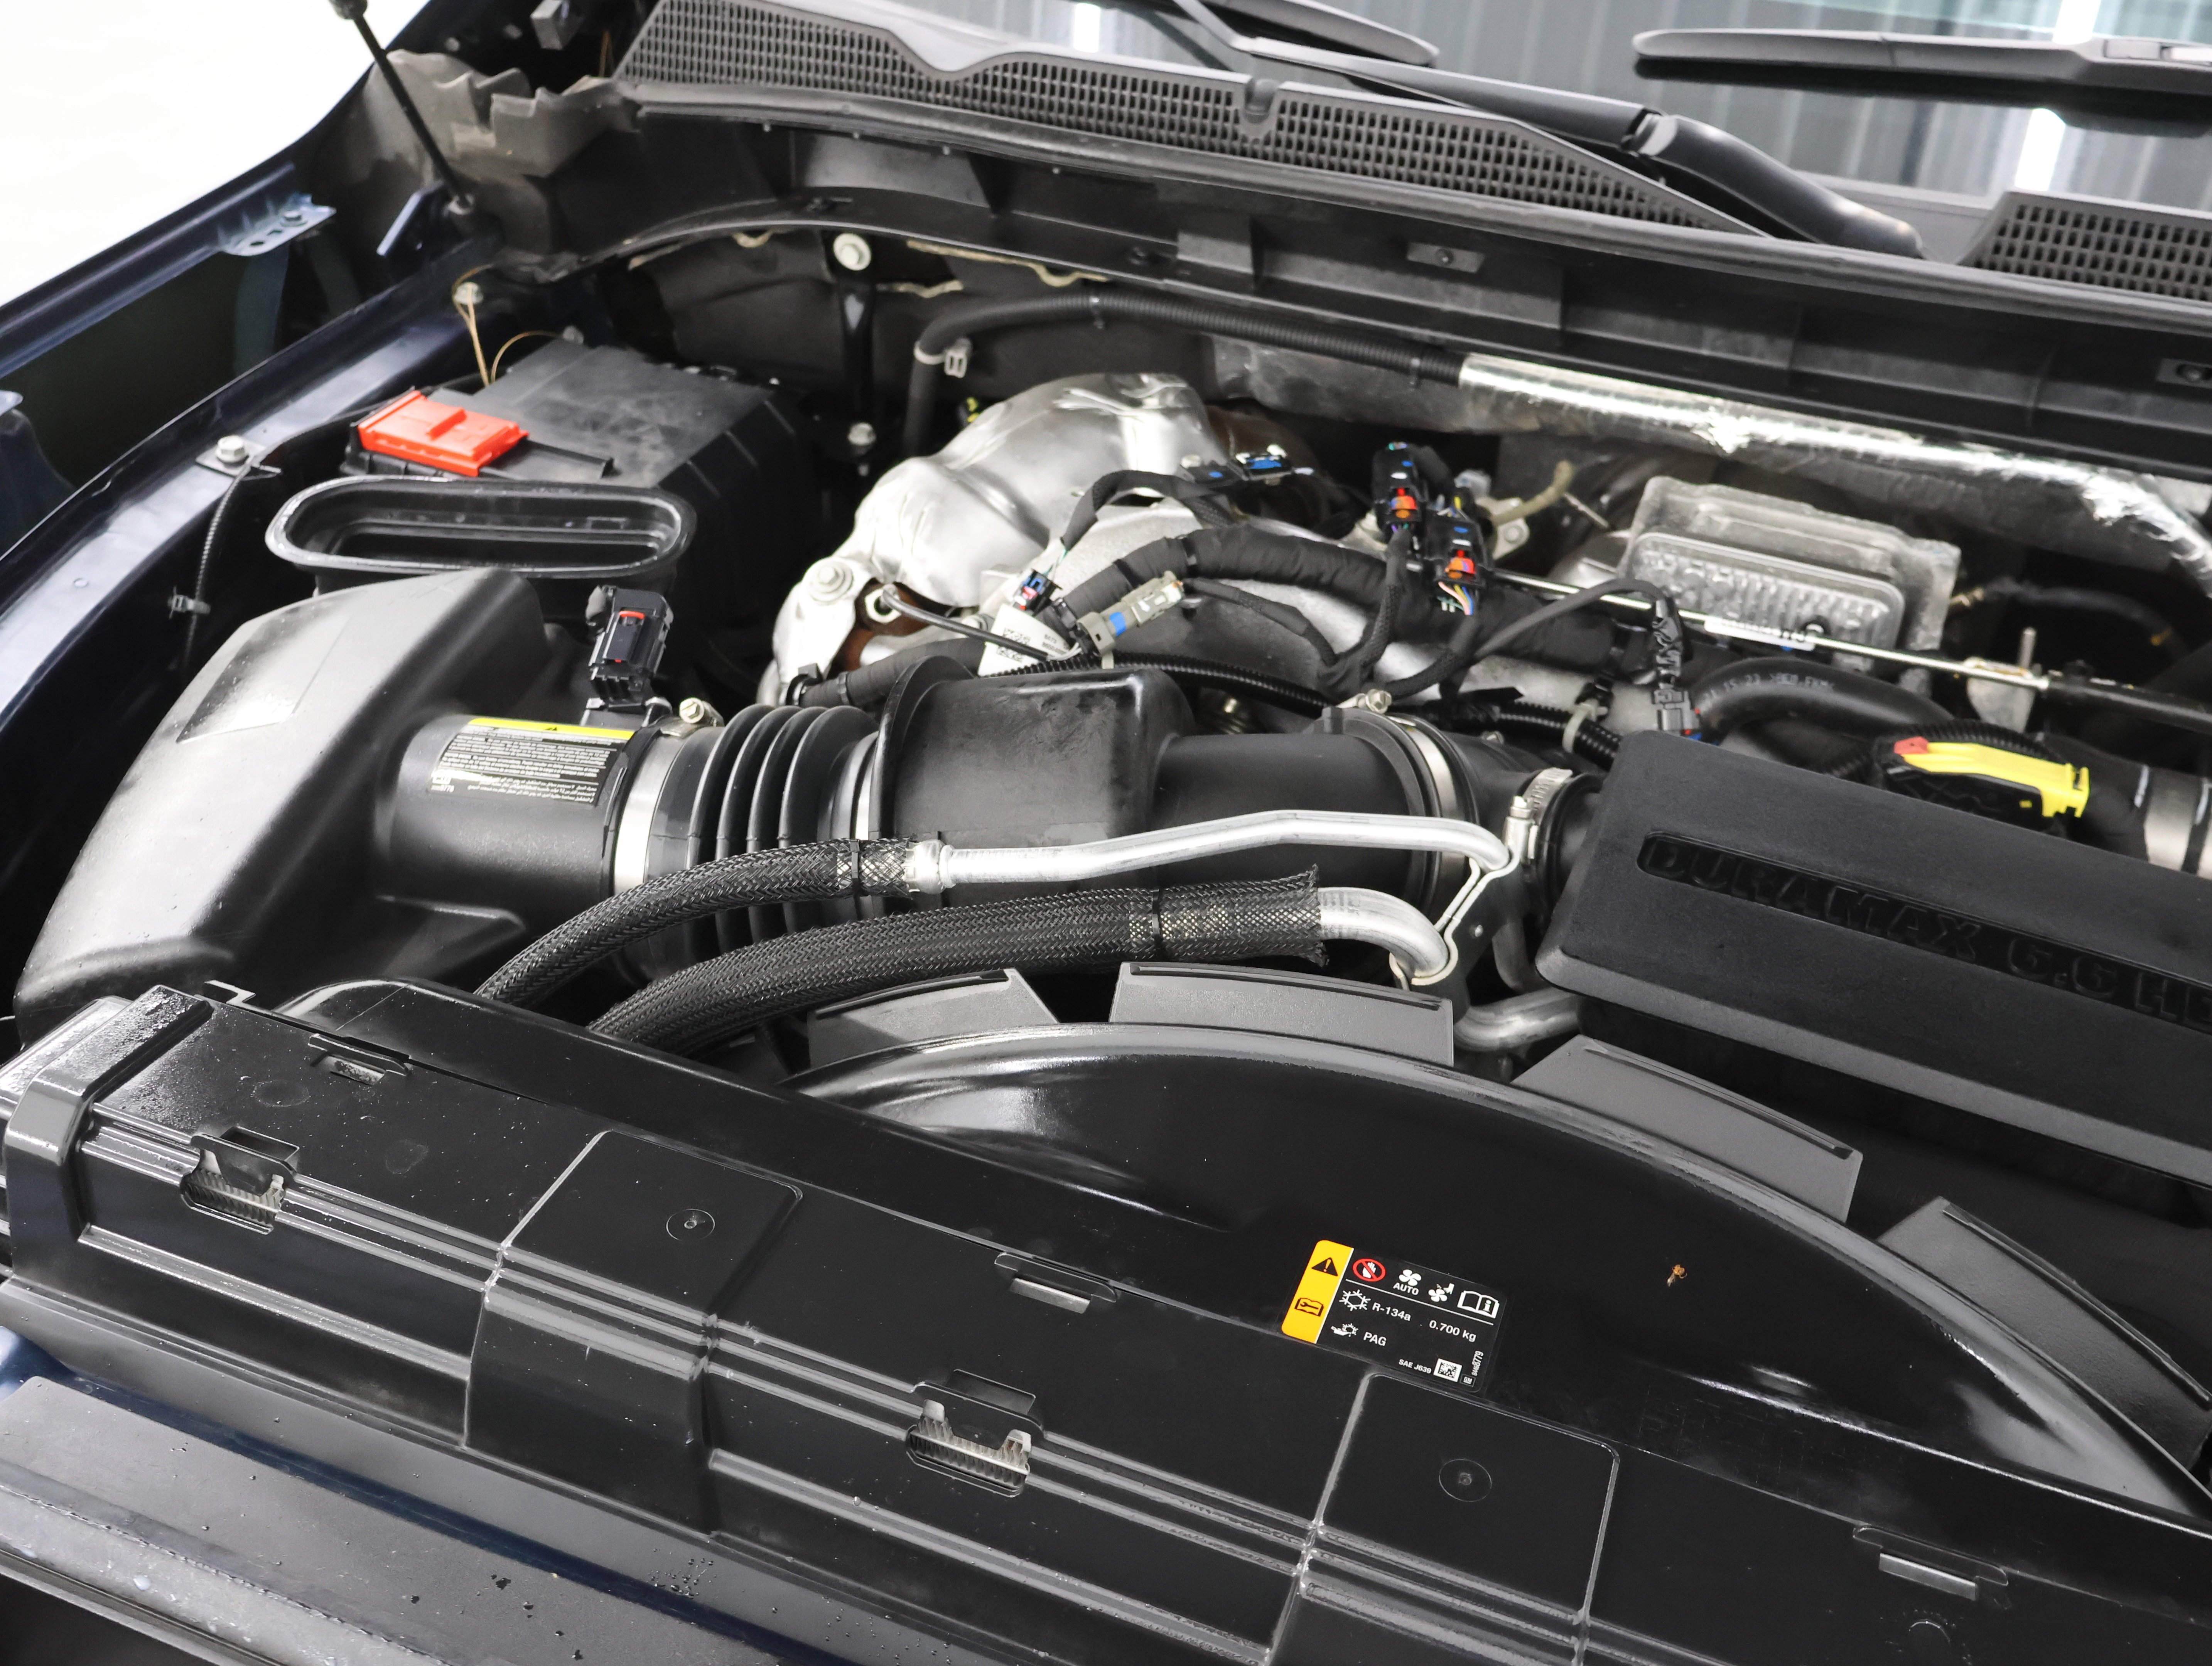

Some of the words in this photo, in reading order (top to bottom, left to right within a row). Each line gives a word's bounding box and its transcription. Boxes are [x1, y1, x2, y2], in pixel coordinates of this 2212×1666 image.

[1647, 839, 1981, 962] DURAMAX
[2008, 936, 2118, 999] 6.6
[1393, 1282, 1419, 1295] AUTO
[1372, 1302, 1411, 1322] R-134a
[1429, 1319, 1461, 1337] 0.700
[1462, 1329, 1477, 1342] kg
[1363, 1331, 1387, 1347] PAG
[1398, 1358, 1414, 1369] SAE
[1414, 1362, 1432, 1374] J639
[1463, 1376, 1473, 1384] GM
